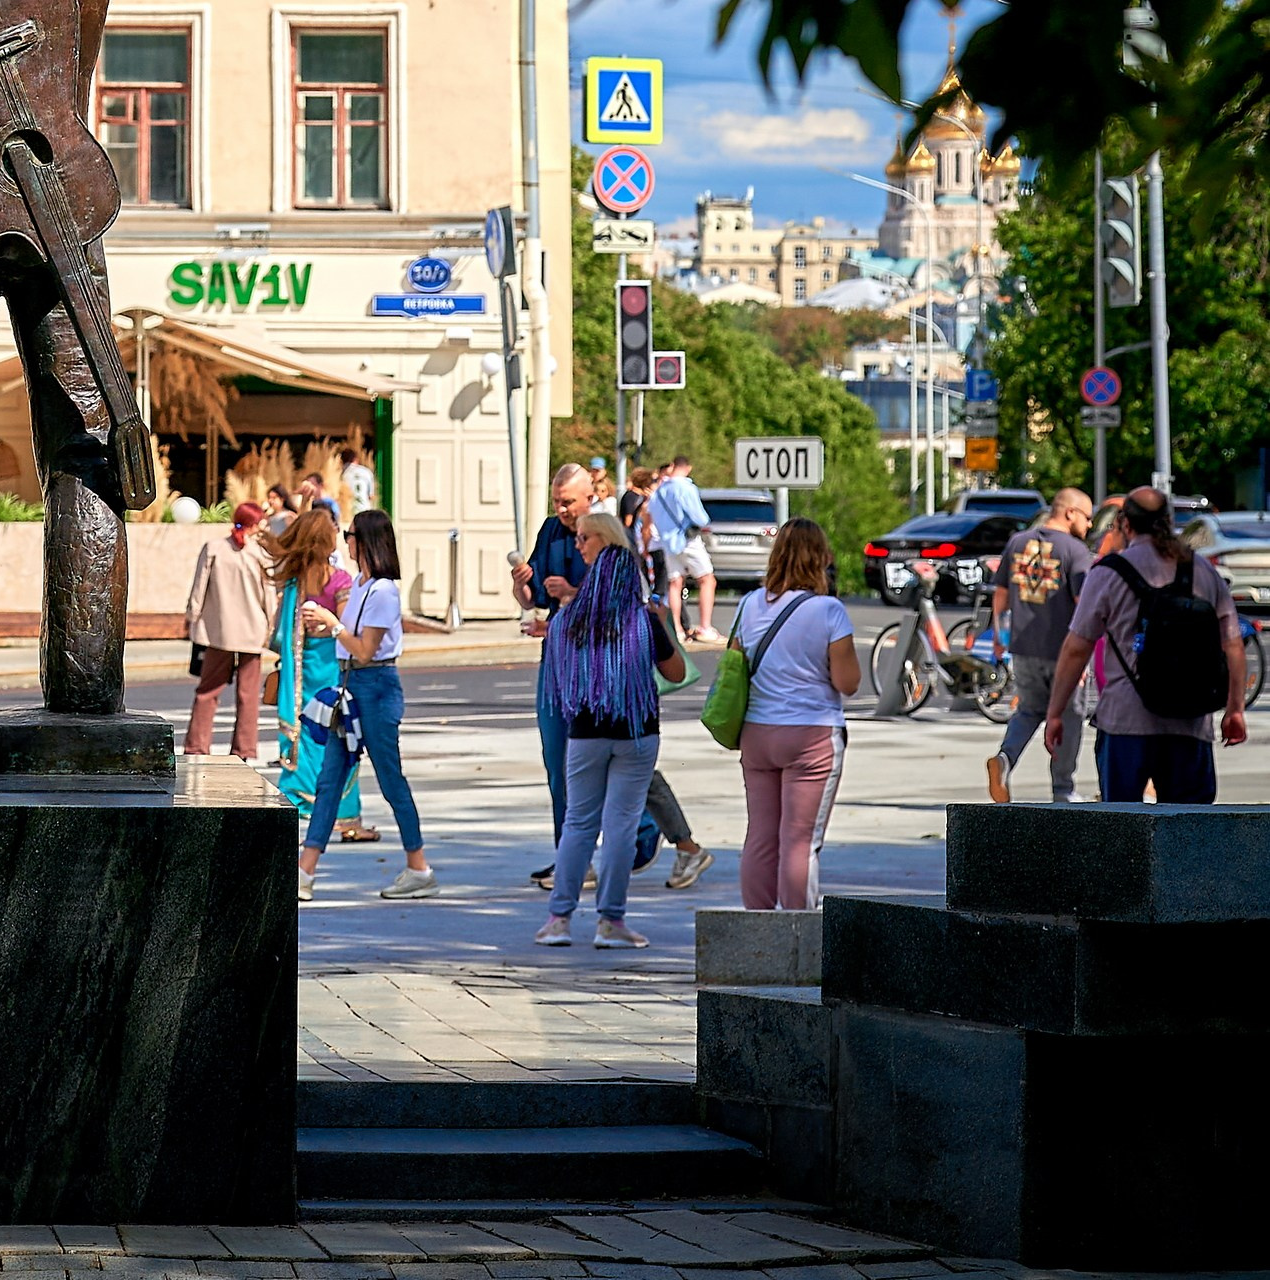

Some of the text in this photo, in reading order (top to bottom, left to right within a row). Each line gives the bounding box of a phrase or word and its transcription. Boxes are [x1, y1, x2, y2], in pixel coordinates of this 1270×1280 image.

[403, 297, 456, 310] ПЕТРОВКА
[972, 373, 993, 399] P
[746, 447, 809, 480] СТОП
